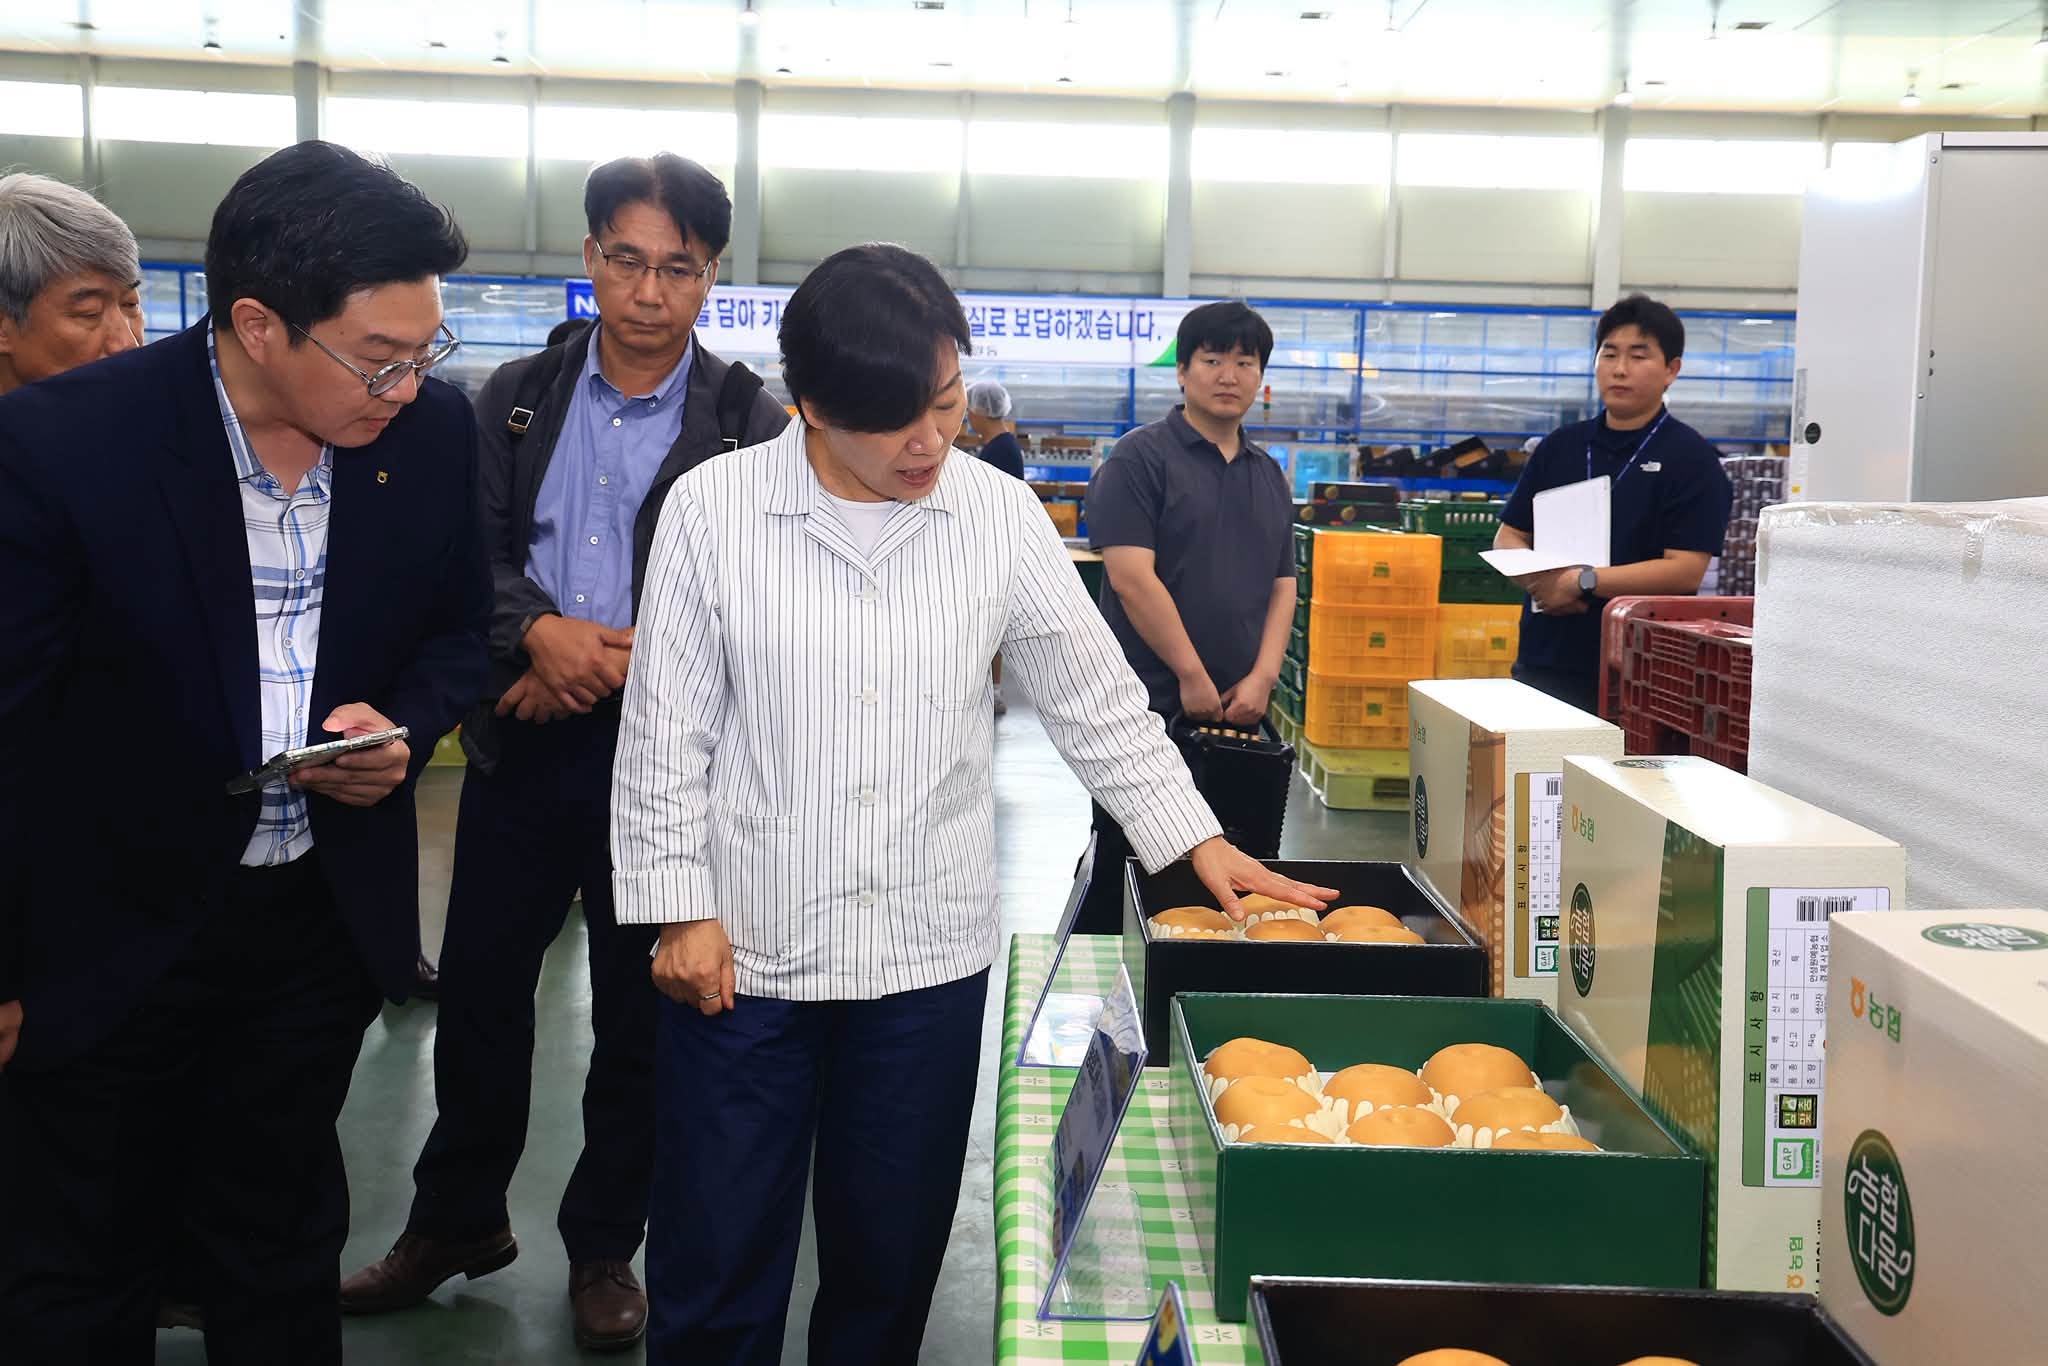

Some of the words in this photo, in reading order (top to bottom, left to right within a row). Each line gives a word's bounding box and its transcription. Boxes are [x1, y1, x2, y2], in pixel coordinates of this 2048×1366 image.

[695, 299, 710, 328] 을
[717, 298, 757, 330] 담아
[762, 300, 784, 331] 키
[969, 306, 1007, 337] 실로
[1013, 308, 1162, 341] 보답하겠습니다.
[1771, 949, 1782, 968] 국산
[1869, 992, 1901, 1043] 농협
[1789, 1032, 1799, 1049] 신고
[1782, 1147, 1793, 1171] GAP
[1848, 1156, 1900, 1229] 농협
[1789, 1236, 1804, 1270] 농협
[1858, 1212, 1911, 1291] 다움
